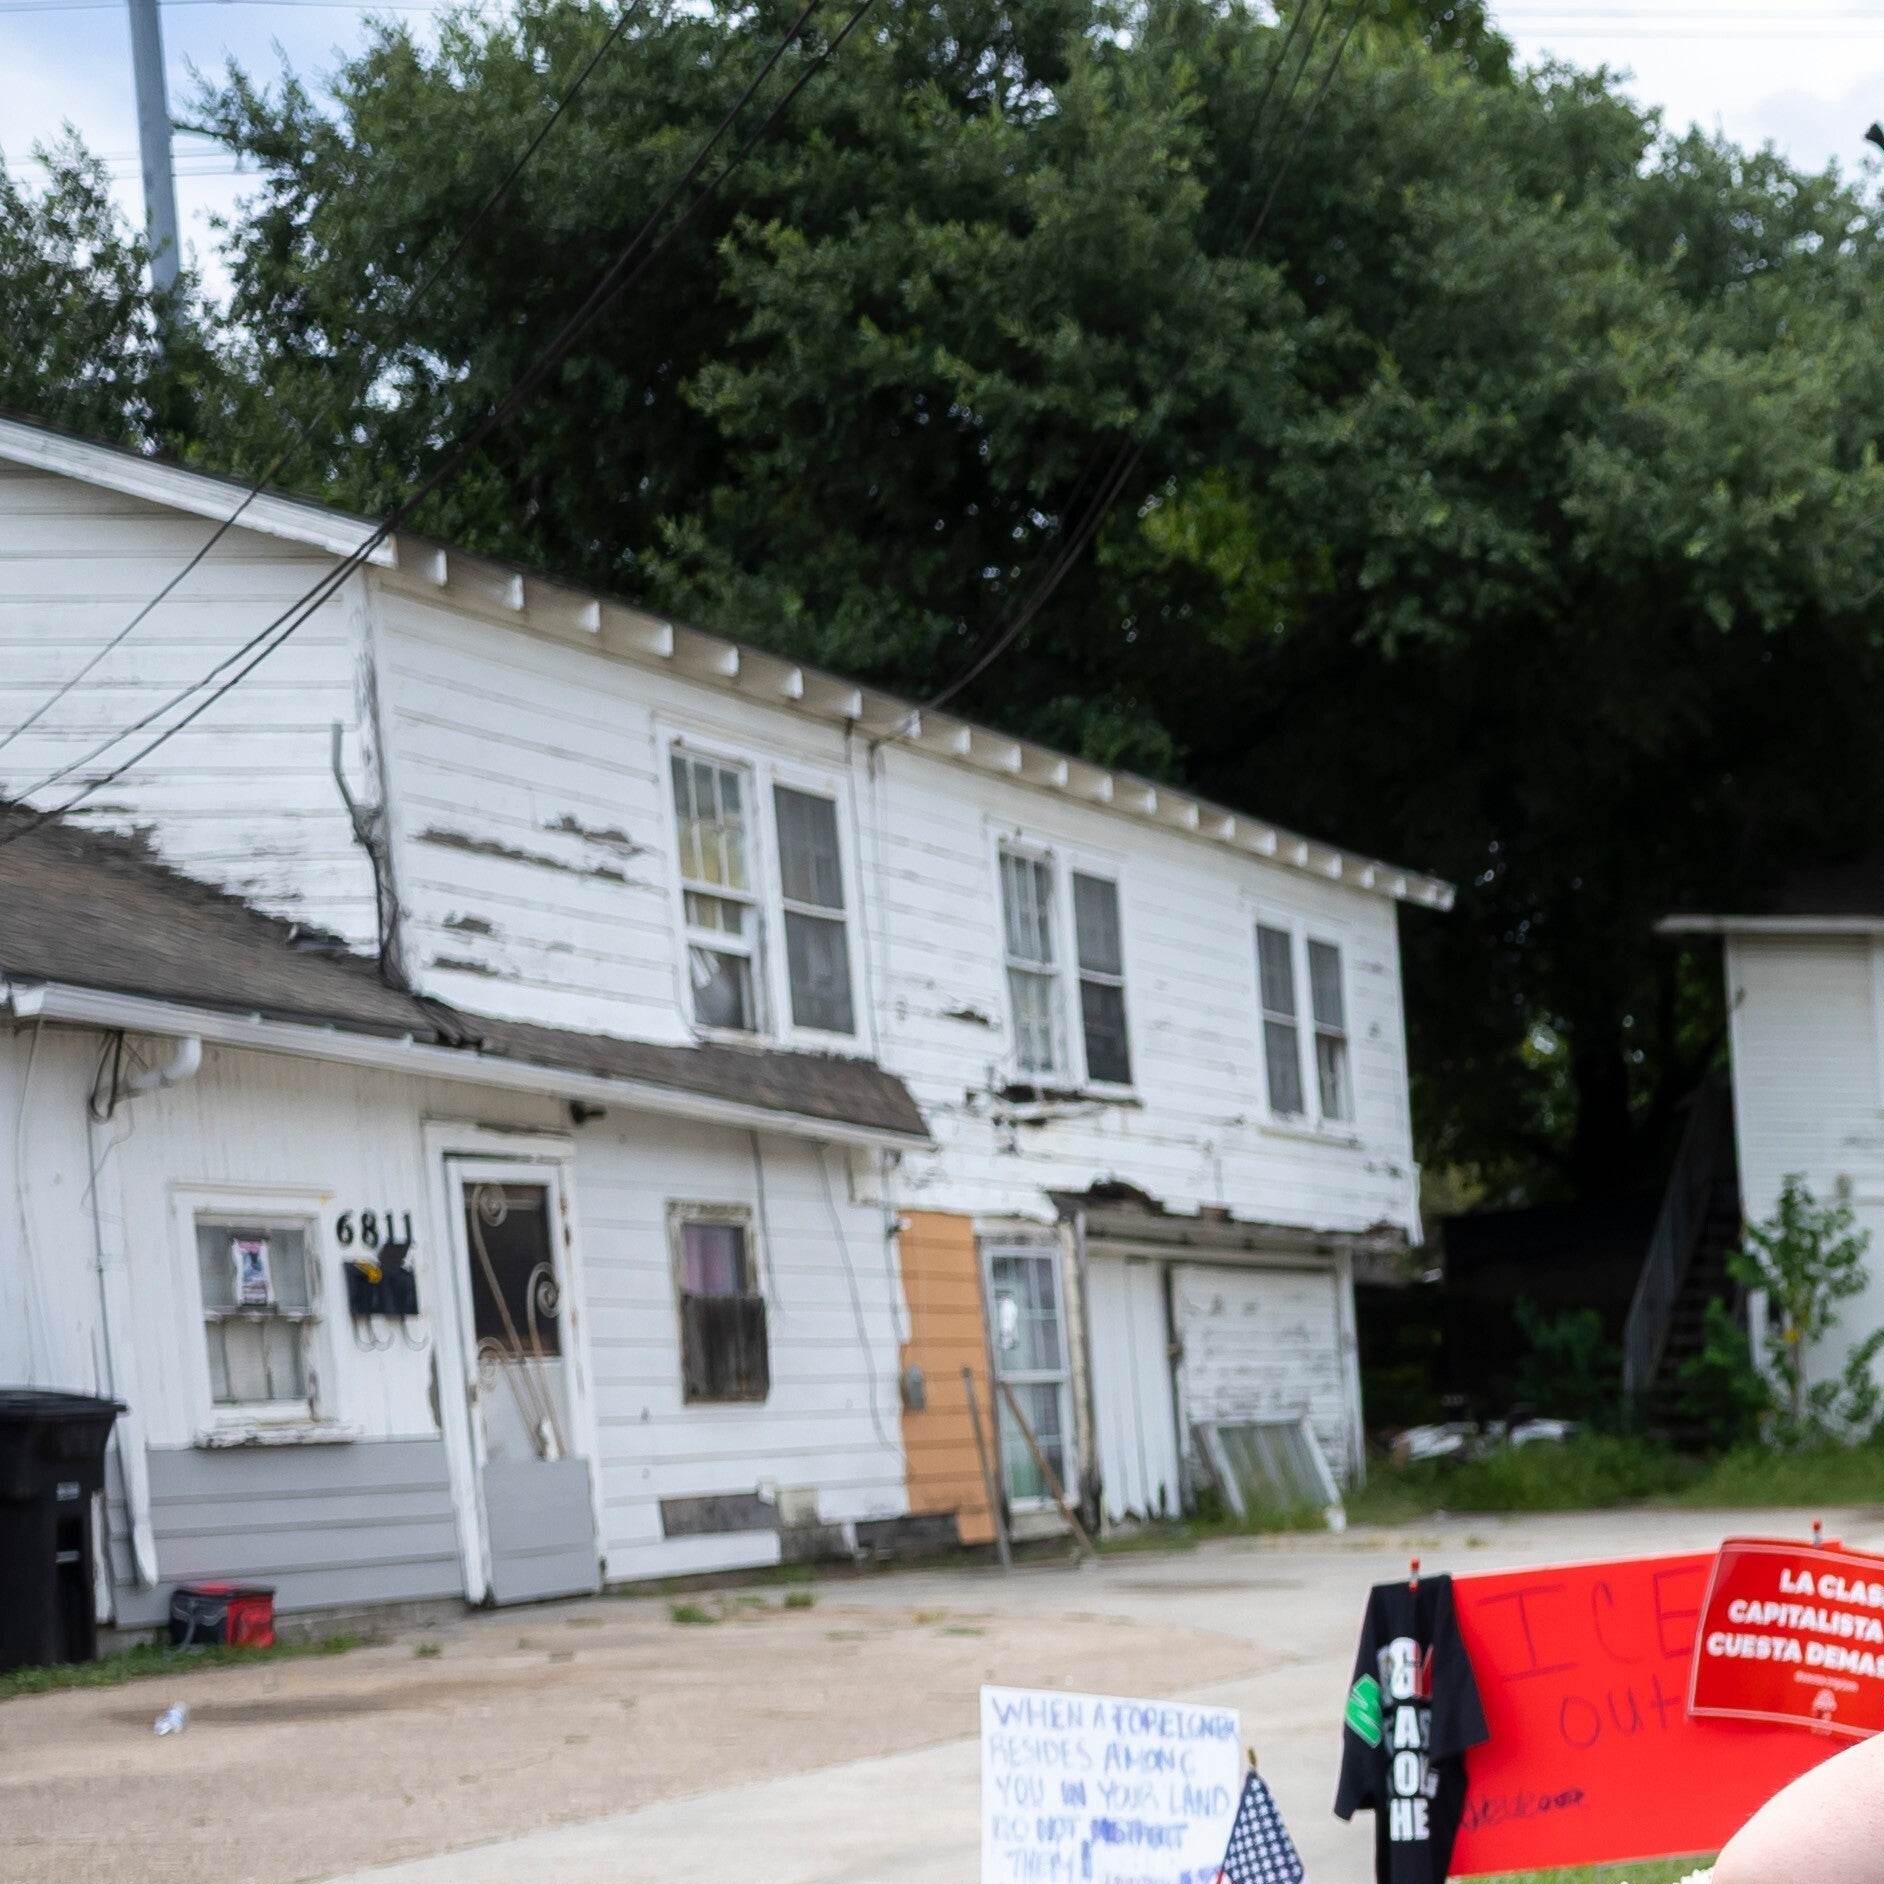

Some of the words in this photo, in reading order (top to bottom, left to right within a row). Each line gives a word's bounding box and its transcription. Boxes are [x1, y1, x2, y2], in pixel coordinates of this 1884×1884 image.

[336, 1212, 411, 1248] 6811
[1779, 1568, 1814, 1596] LA
[1477, 1564, 1706, 1683] ICE
[1727, 1599, 1884, 1644] CAPITALISTA
[1706, 1632, 1801, 1664] CUESTA
[992, 1696, 1083, 1730] WHEN
[1093, 1702, 1106, 1732] A
[996, 1775, 1044, 1807] YOU
[1097, 1780, 1160, 1813] YOUR
[1169, 1781, 1231, 1817] LAND
